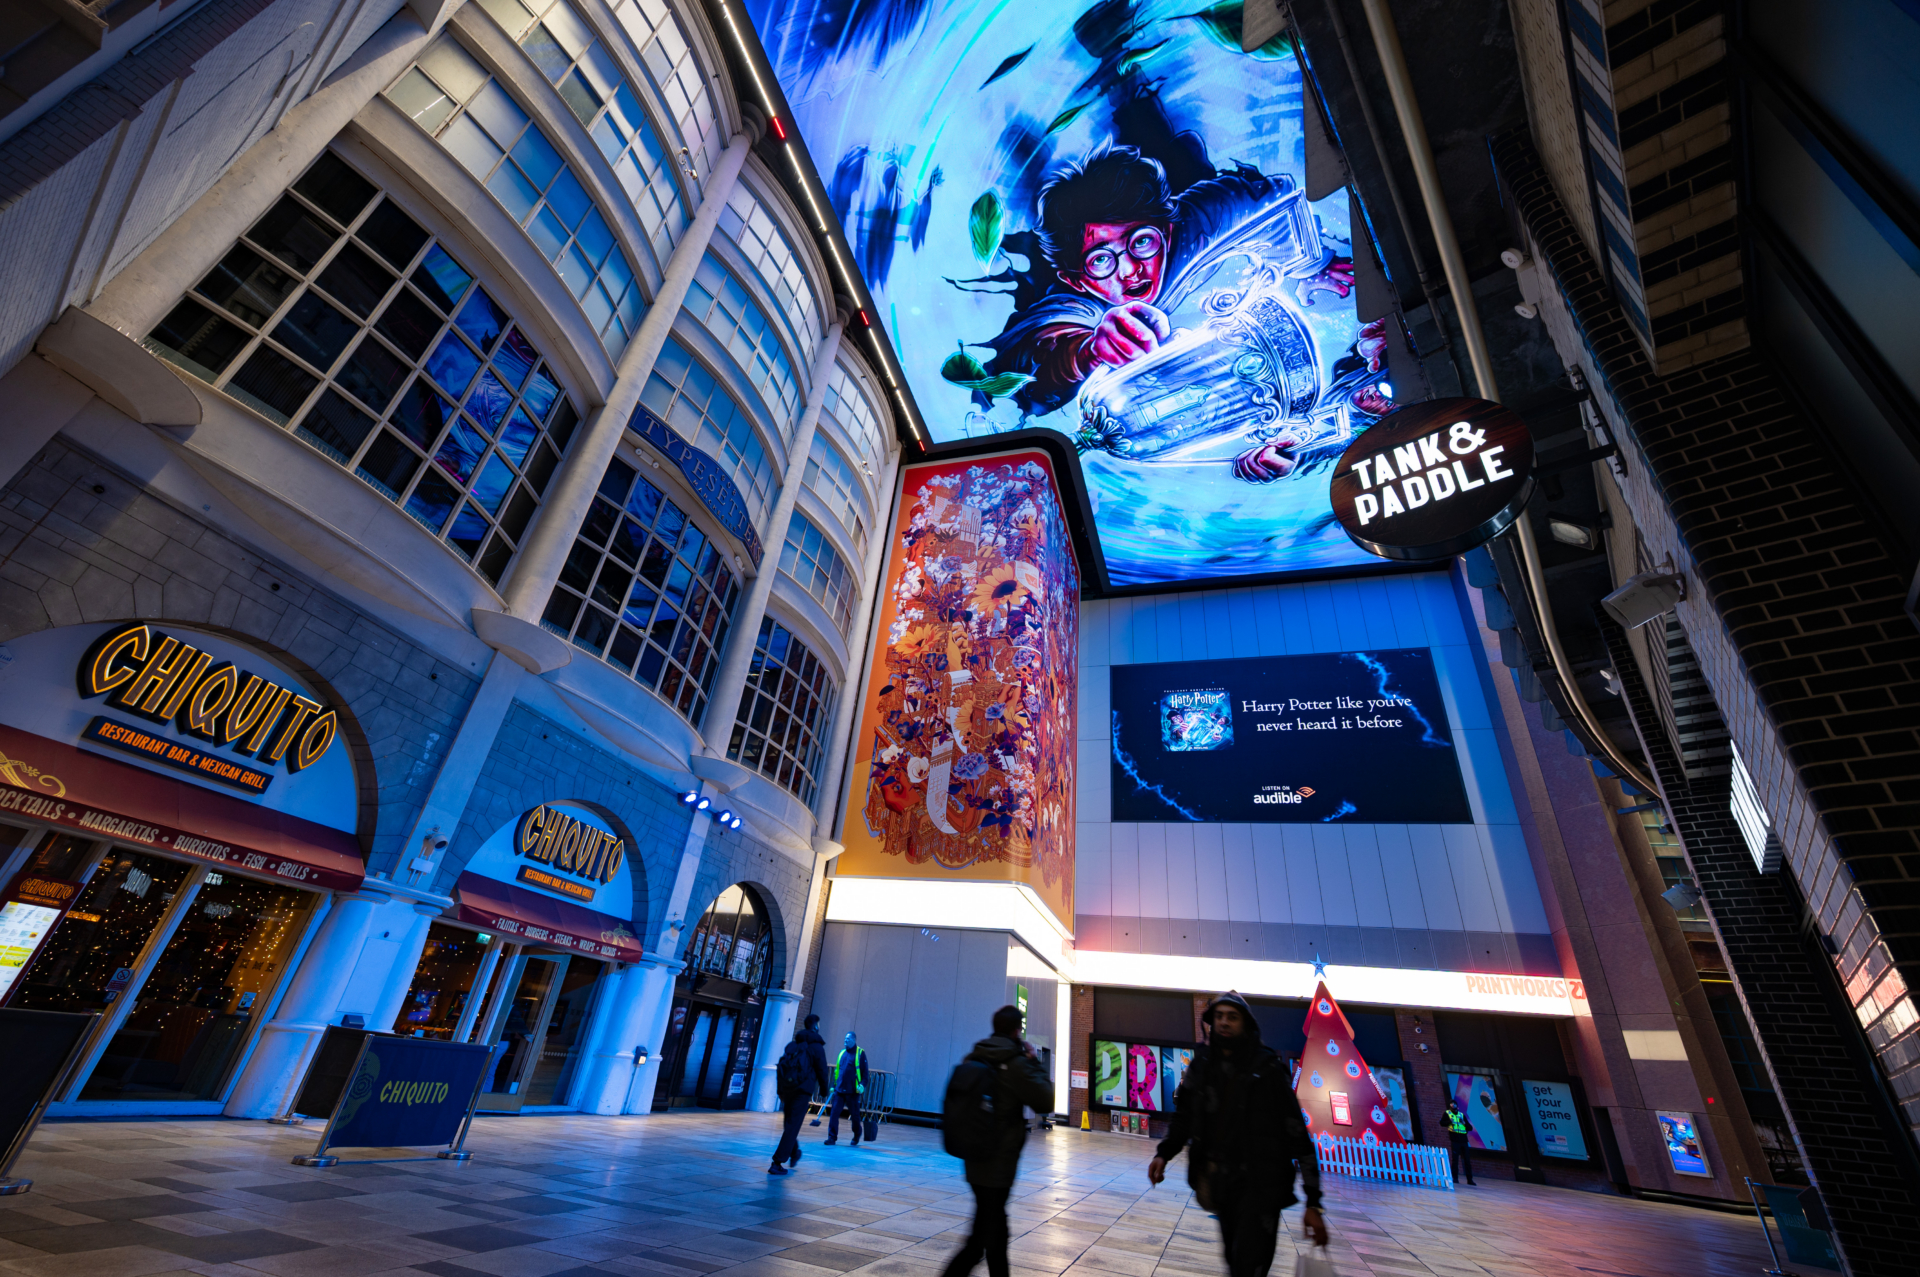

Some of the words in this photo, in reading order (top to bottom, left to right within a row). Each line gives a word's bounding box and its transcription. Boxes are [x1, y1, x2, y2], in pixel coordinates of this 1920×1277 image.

[1351, 432, 1448, 490] TANK
[1448, 421, 1487, 455] &
[645, 415, 761, 563] TYPESETTERS
[1354, 445, 1514, 526] PADDLE
[91, 624, 337, 770] CHIQUITO
[1170, 693, 1194, 708] Harry
[1194, 692, 1223, 706] Potter
[1241, 700, 1285, 716] Harry
[1288, 698, 1332, 711] Potter
[1335, 696, 1364, 709] like
[1367, 694, 1412, 713] you've
[1257, 721, 1293, 732] never
[1296, 716, 1338, 731] heard
[1342, 716, 1353, 729] it
[1355, 715, 1403, 729] before
[98, 722, 170, 756] RESTAURANT
[166, 745, 190, 764] BAR
[188, 755, 198, 766] &
[198, 756, 240, 780] MEXICAN
[239, 771, 267, 789] GRILL
[1253, 792, 1302, 804] audible
[79, 810, 160, 843] MARGARITAS
[173, 834, 231, 861] BURRITOS
[241, 852, 268, 870] FISH
[276, 861, 310, 880] GRILLS
[522, 804, 625, 883] CHIQUITO
[19, 877, 75, 900] CHIQUITO
[524, 868, 553, 886] RESTAURANT
[551, 877, 562, 889] BAR
[564, 882, 583, 896] MEXICAN
[581, 888, 594, 899] GRILL
[496, 917, 520, 933] FAJITAS
[524, 925, 549, 941] BURGERS
[553, 933, 573, 947] STEAKS
[578, 939, 596, 952] WRAPS
[1465, 975, 1567, 998] PRINTWORKS
[379, 1080, 449, 1107] CHIQUITO
[1532, 1086, 1553, 1096] get
[1535, 1097, 1562, 1108] your
[1538, 1109, 1572, 1120] game
[1541, 1122, 1557, 1131] on
